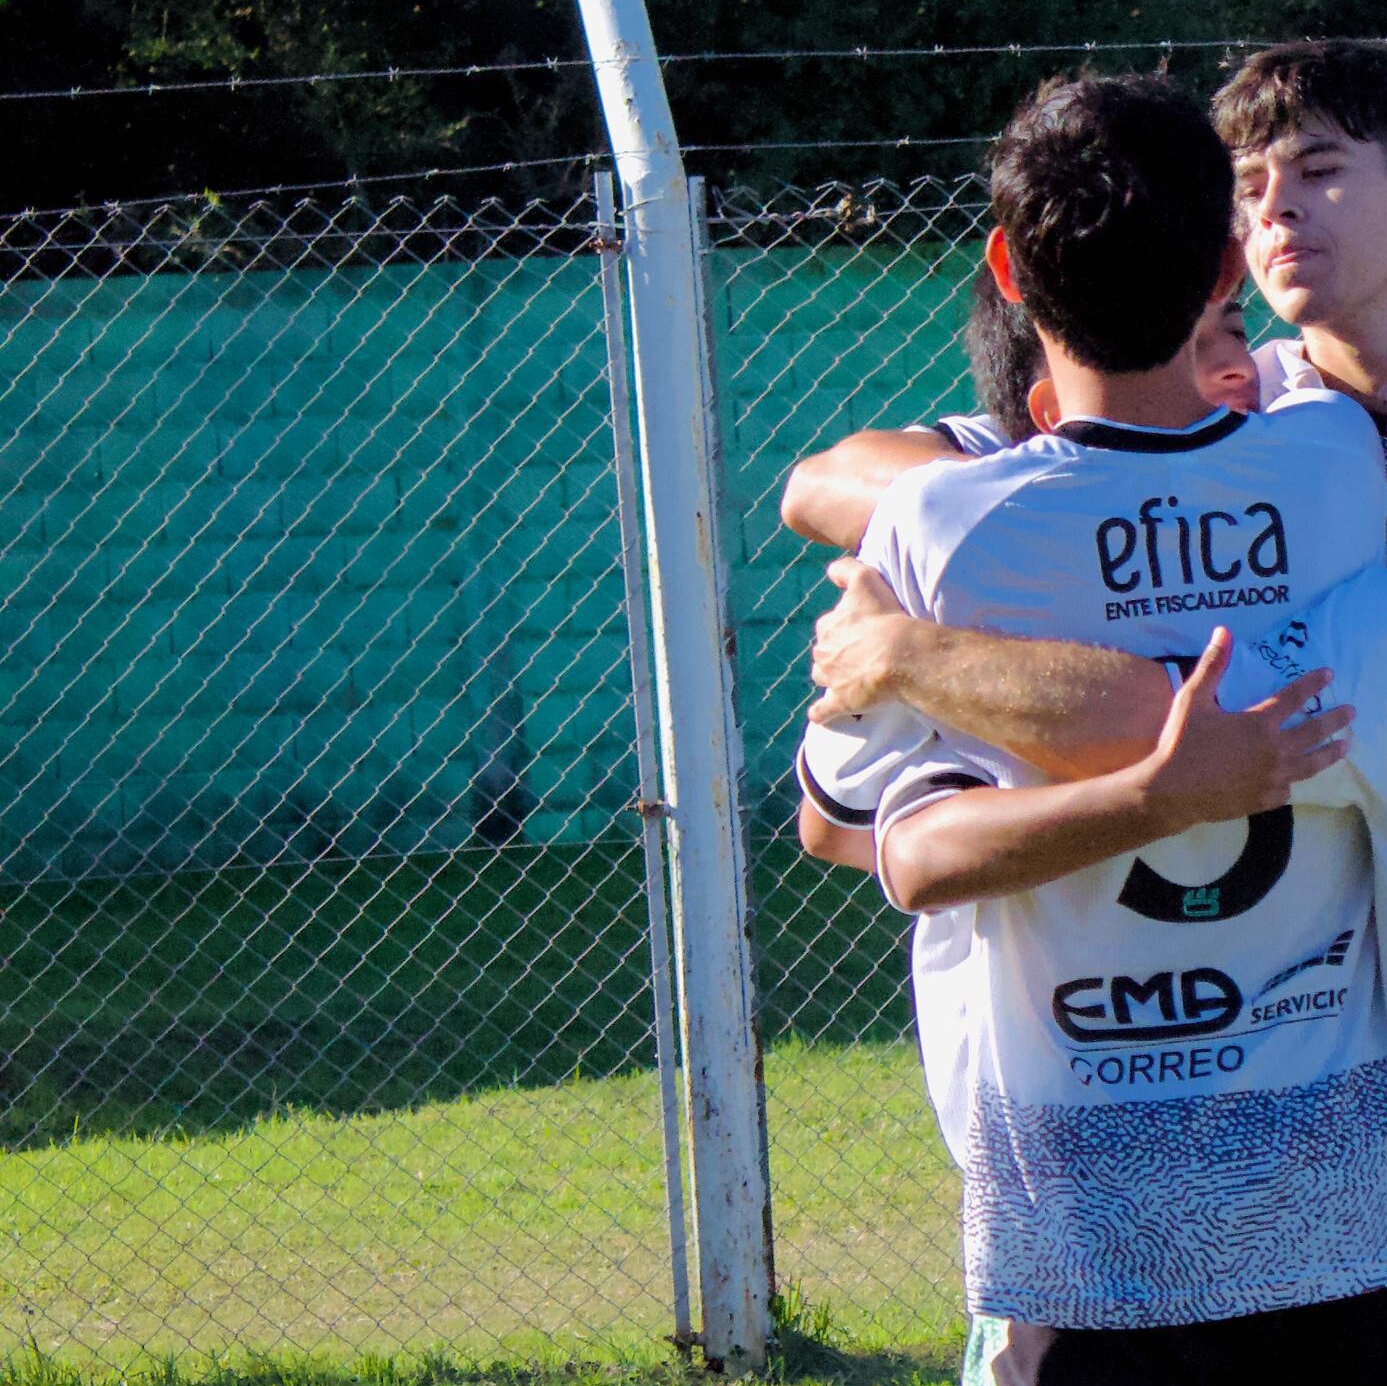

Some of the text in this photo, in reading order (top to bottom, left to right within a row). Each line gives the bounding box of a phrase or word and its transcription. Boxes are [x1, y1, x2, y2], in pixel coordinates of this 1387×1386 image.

[1096, 495, 1289, 593] efica
[1105, 585, 1290, 622] ENTE FISCALIZADOR
[1070, 1045, 1244, 1086] CORREO
